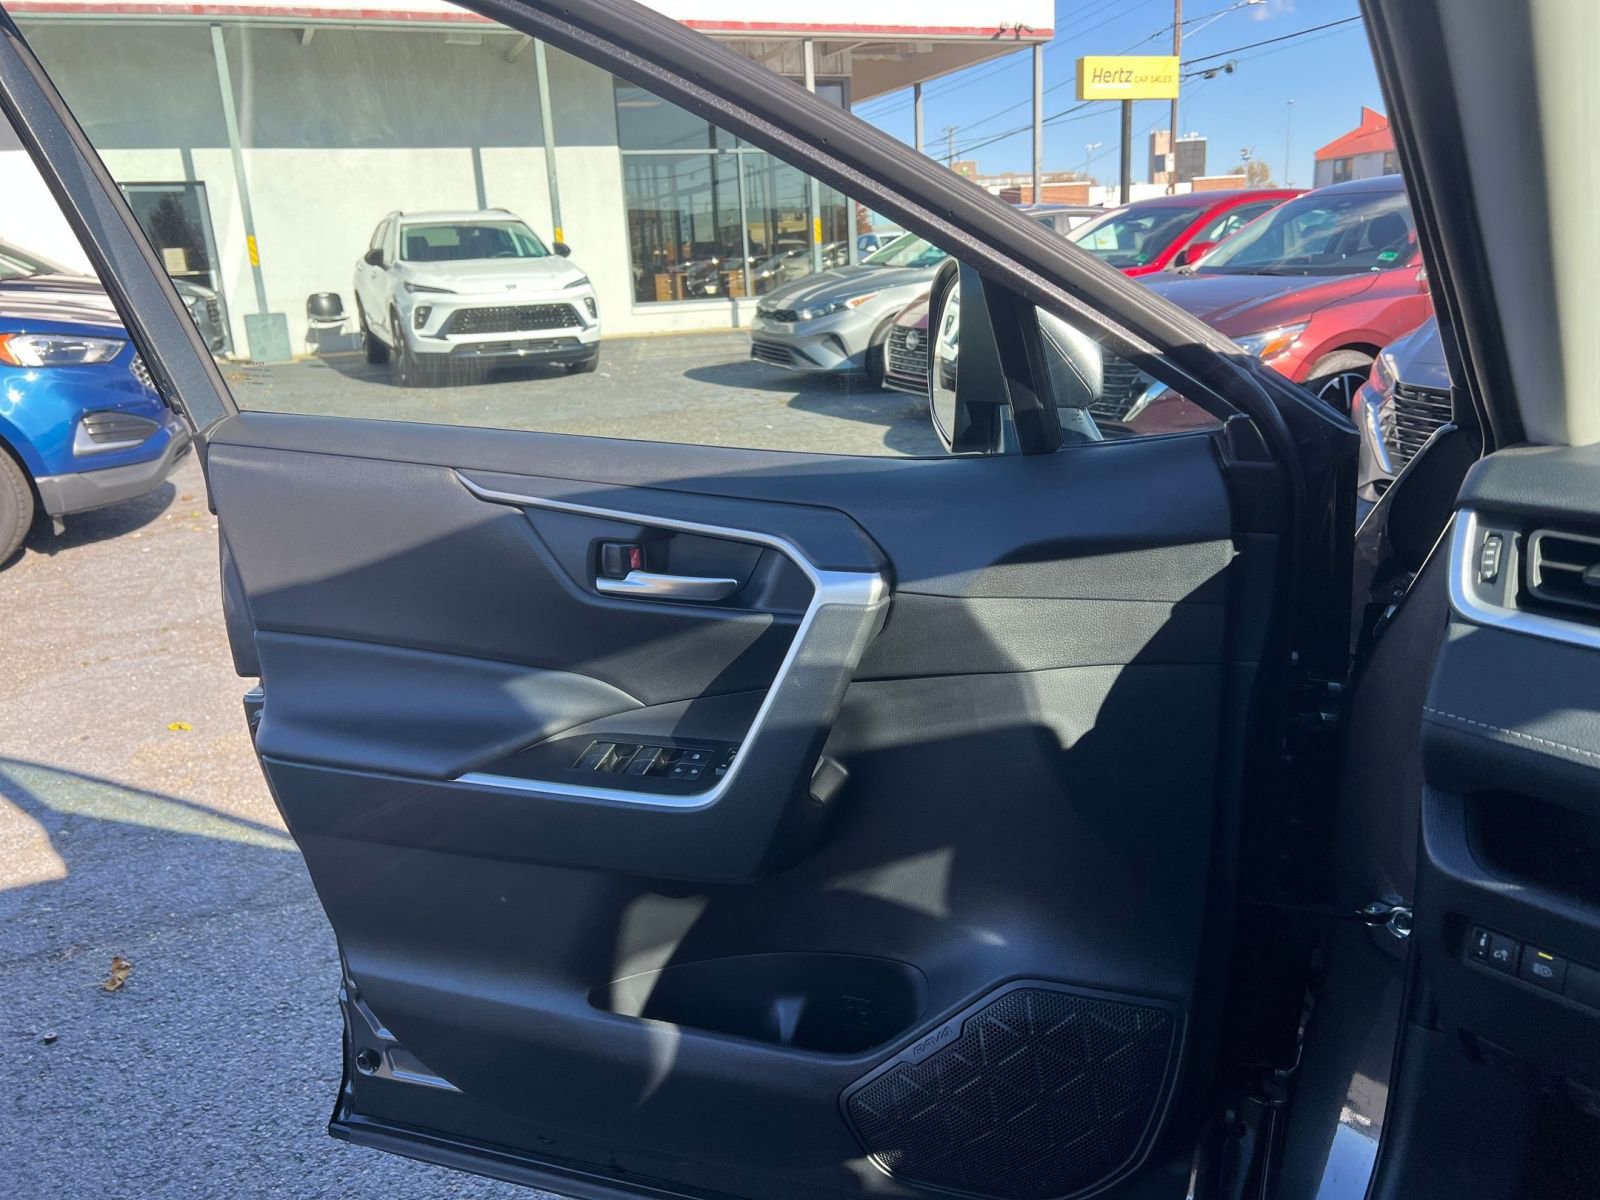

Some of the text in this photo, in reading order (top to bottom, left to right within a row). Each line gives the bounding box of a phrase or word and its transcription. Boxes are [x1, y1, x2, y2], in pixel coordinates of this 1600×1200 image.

[1092, 67, 1133, 83] Hertz
[1150, 75, 1172, 83] SALES
[913, 1025, 953, 1057] RAV4
